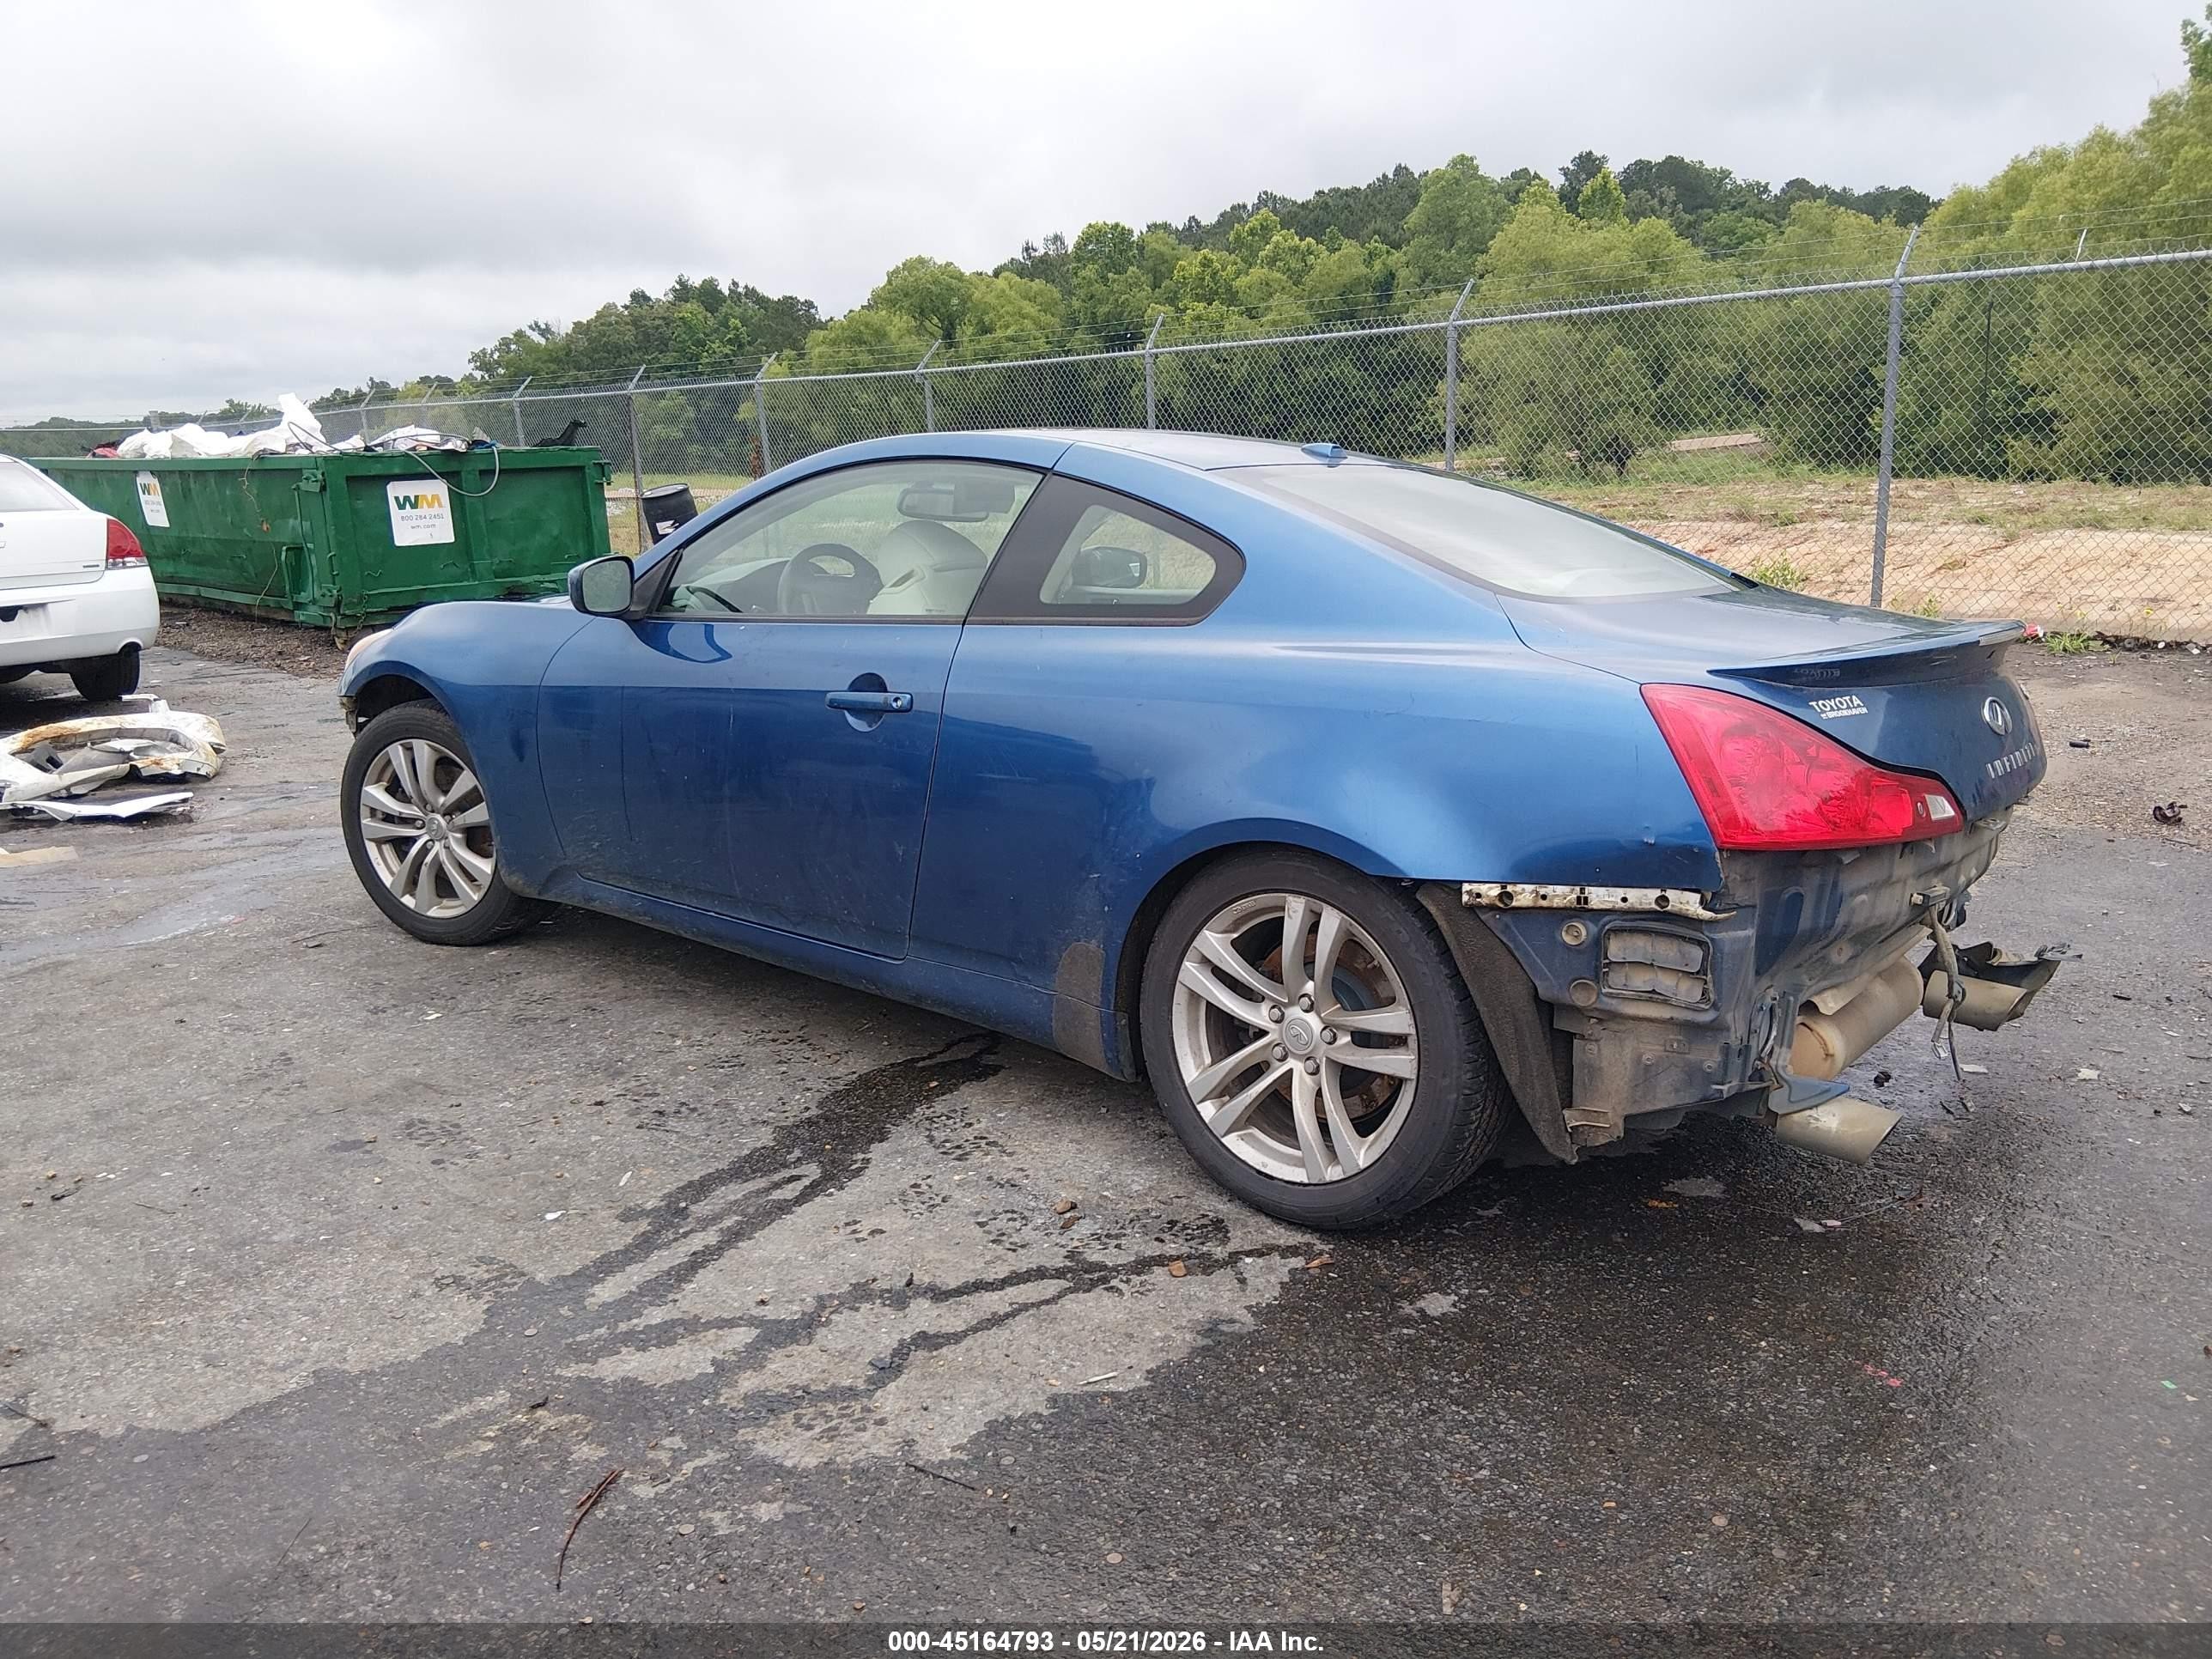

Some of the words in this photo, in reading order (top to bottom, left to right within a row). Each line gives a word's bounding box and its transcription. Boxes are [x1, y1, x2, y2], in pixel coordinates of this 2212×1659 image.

[139, 483, 160, 496] WM
[394, 494, 443, 510] WM
[1808, 695, 1864, 713] TOYOTA
[1985, 742, 2036, 779] INFINITI
